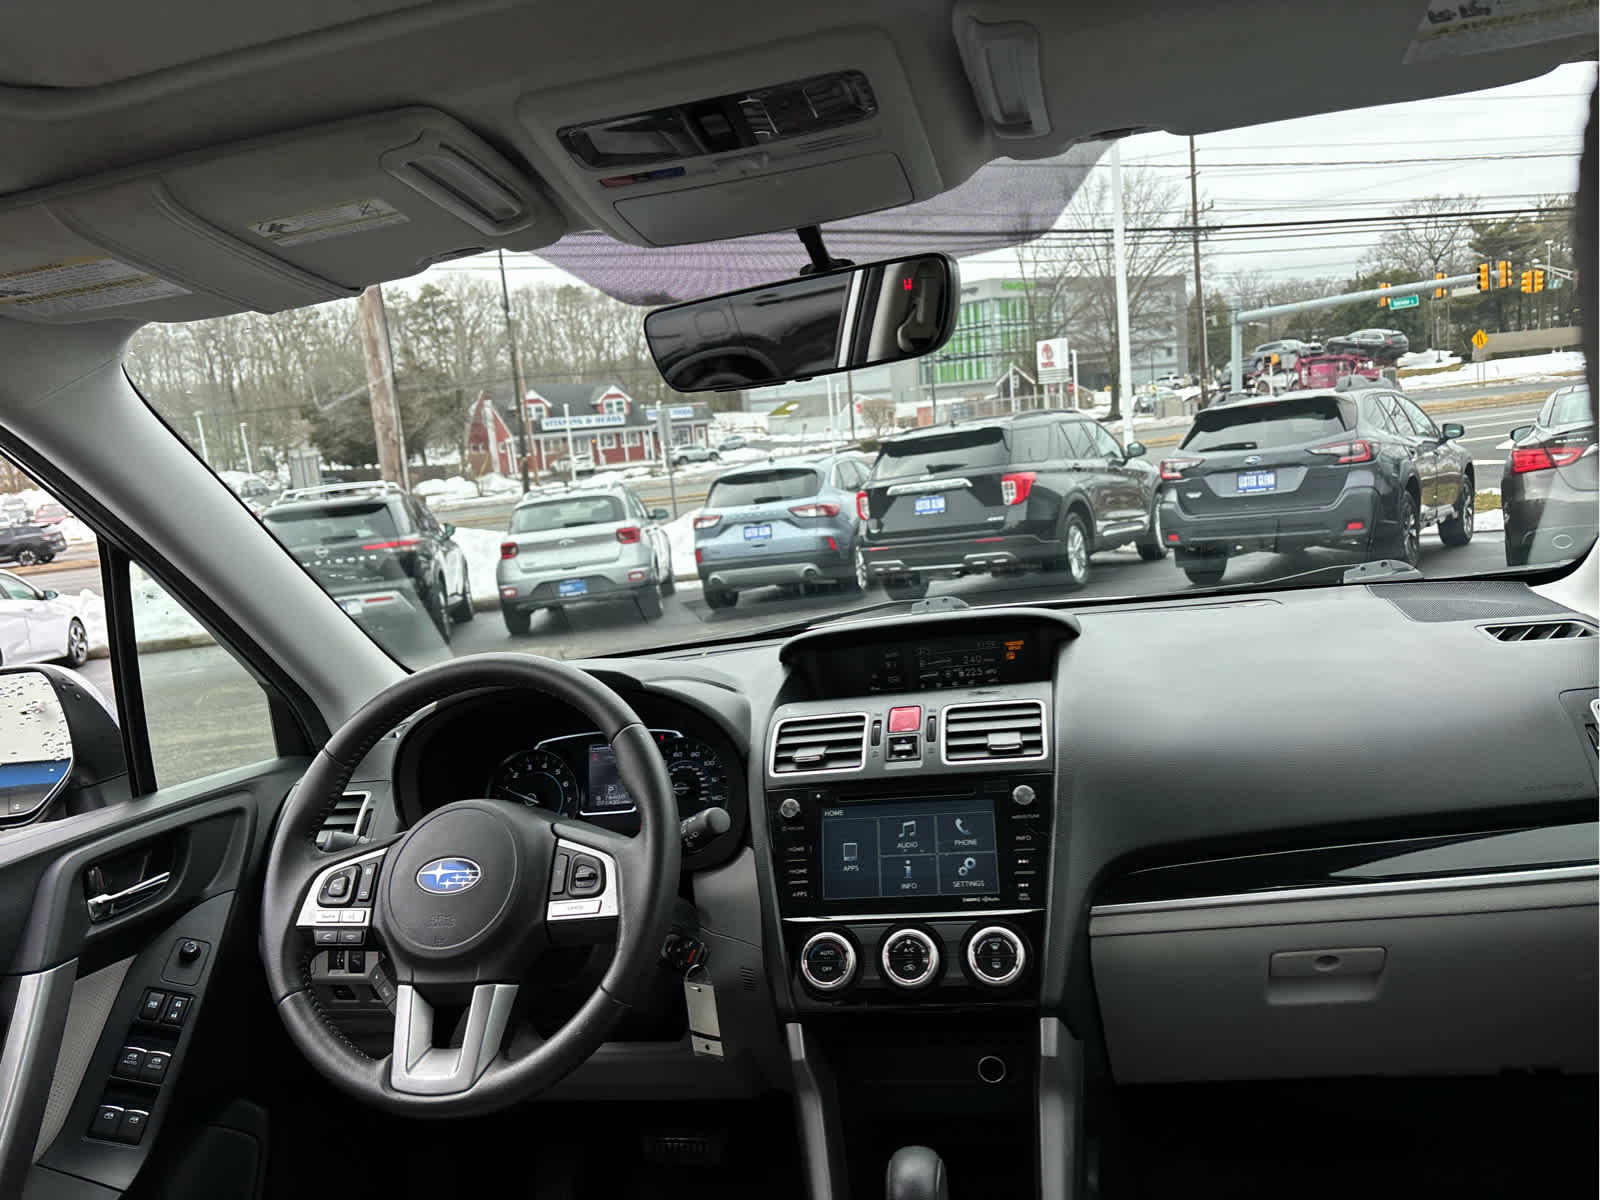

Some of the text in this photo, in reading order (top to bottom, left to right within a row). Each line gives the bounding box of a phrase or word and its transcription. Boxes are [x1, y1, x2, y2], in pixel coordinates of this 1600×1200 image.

[824, 809, 844, 817] HOME
[896, 841, 919, 849] AUDIO
[954, 838, 977, 847] PHONE
[901, 882, 918, 890] INFO
[952, 879, 985, 888] SETTINGS
